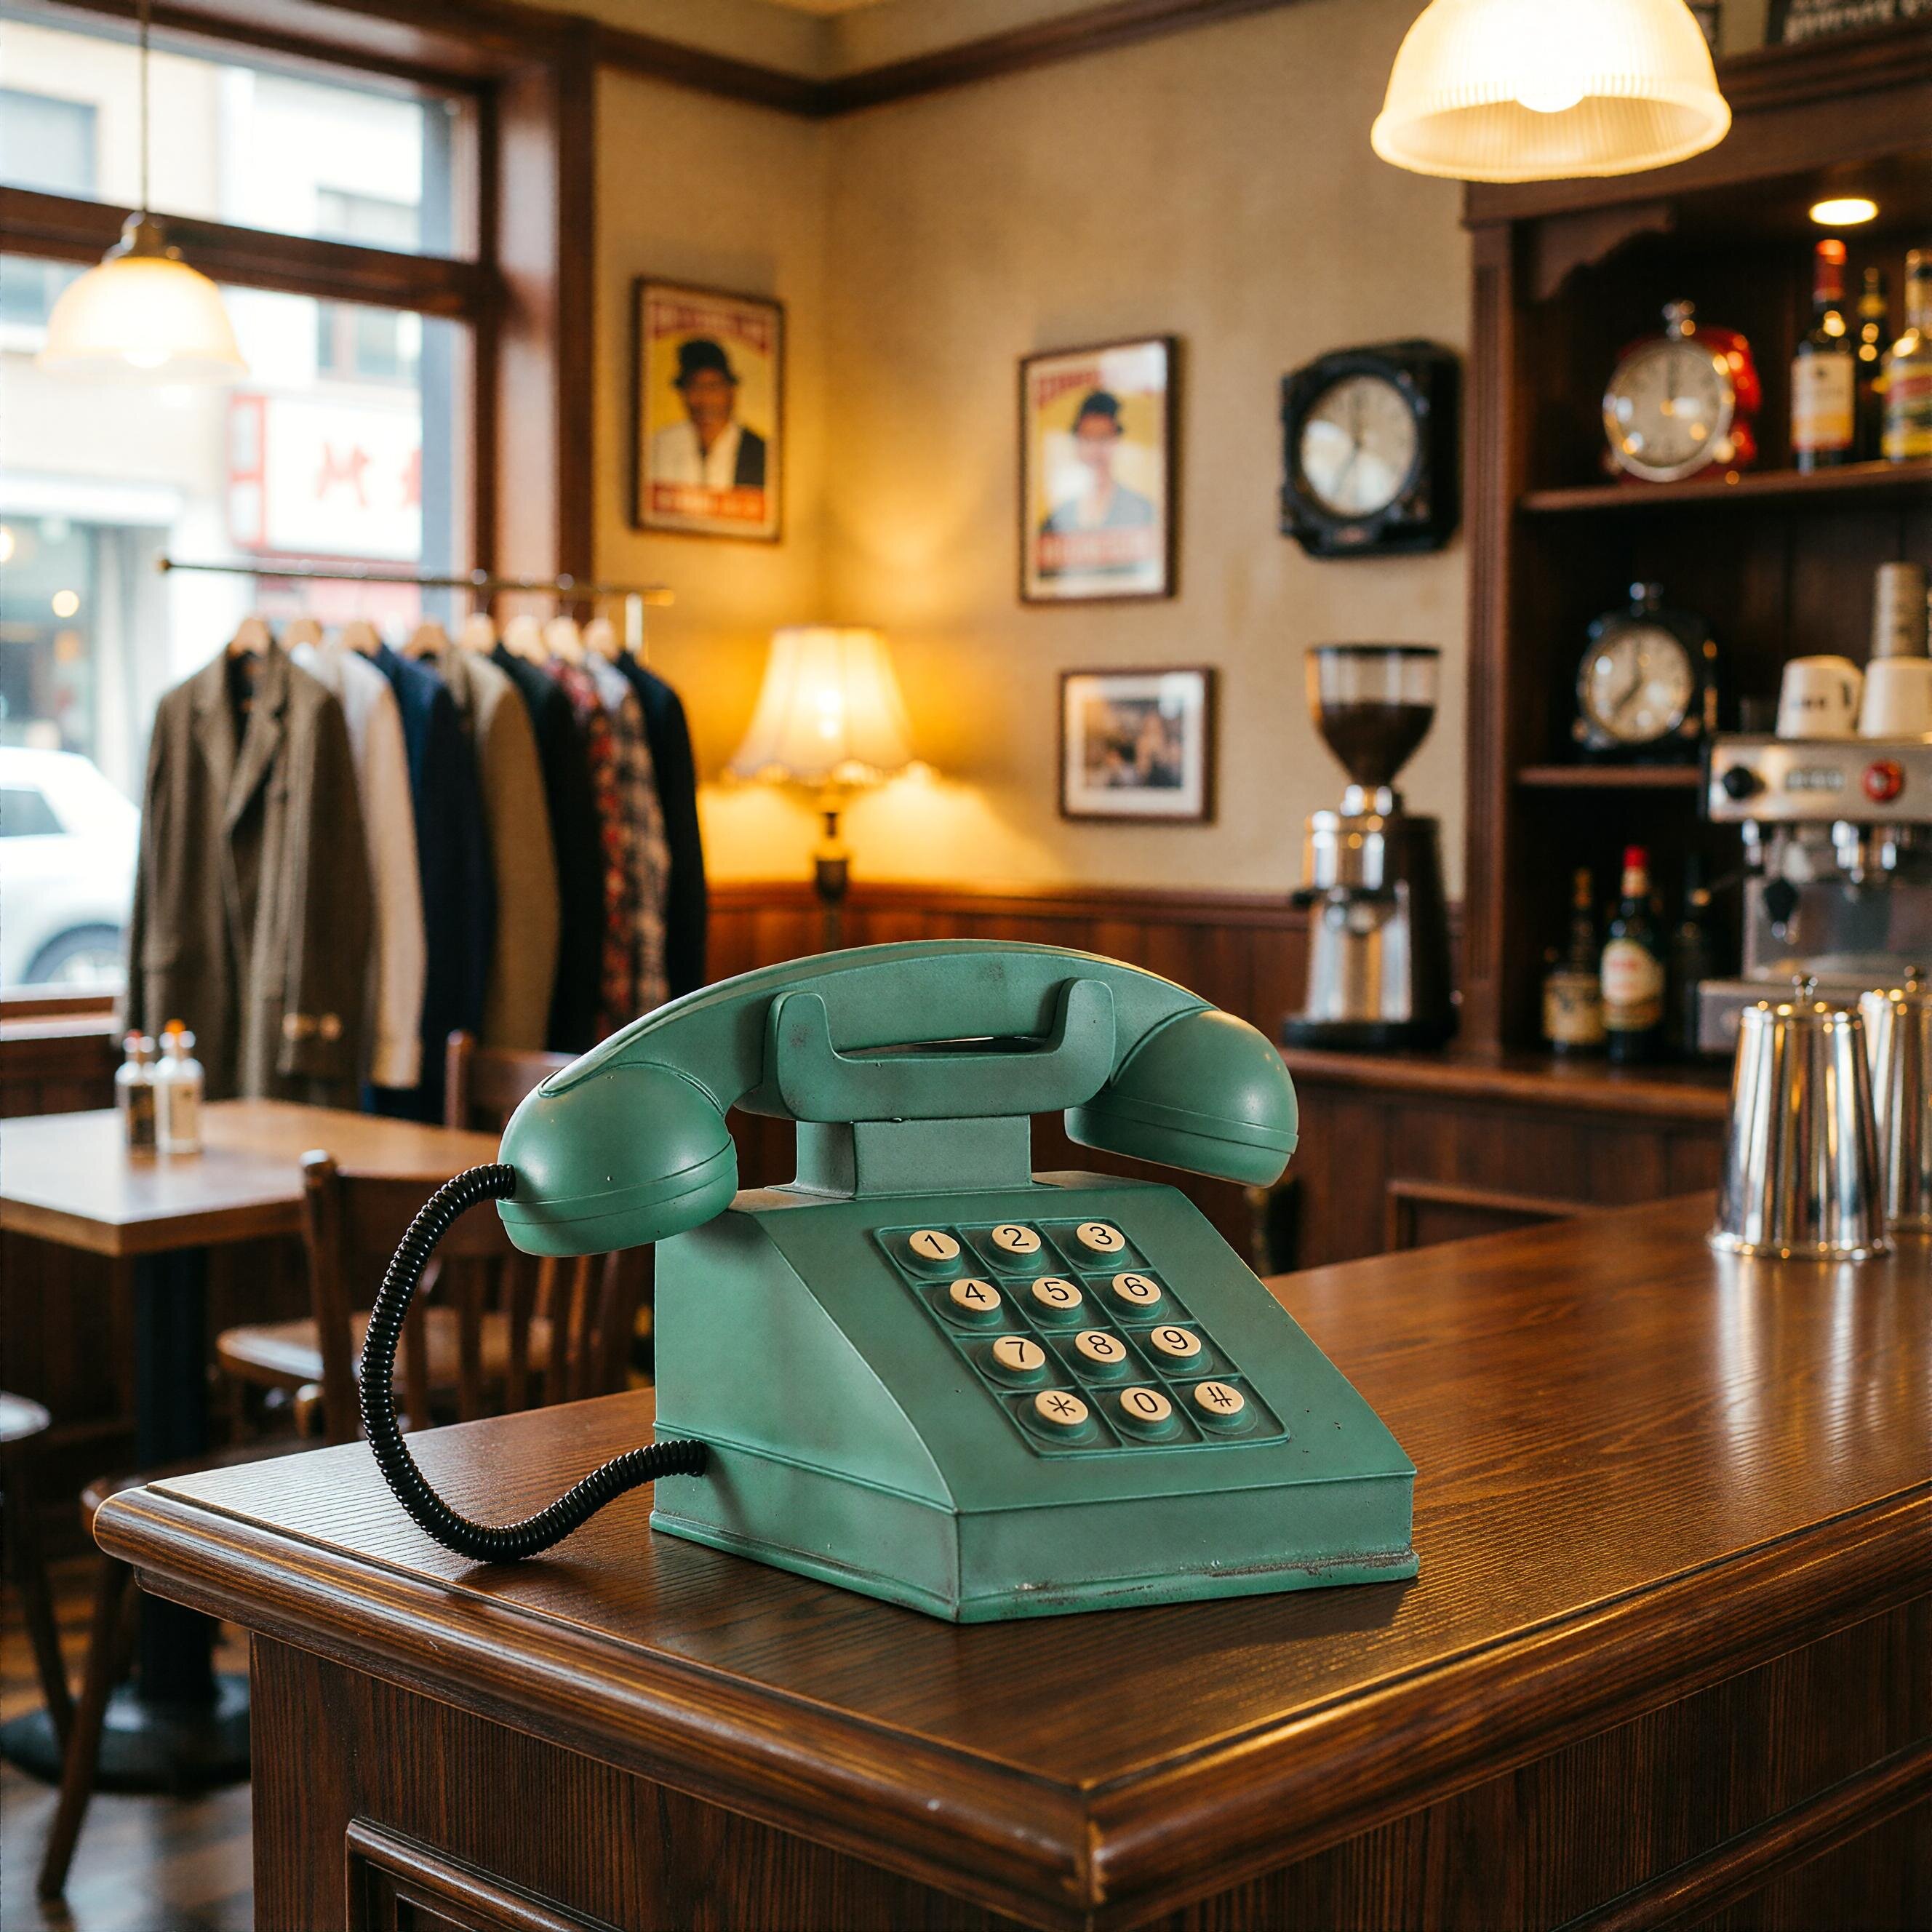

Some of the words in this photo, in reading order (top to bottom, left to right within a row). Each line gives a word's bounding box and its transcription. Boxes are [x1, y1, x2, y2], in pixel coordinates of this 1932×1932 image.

[924, 1234, 945, 1254] 1
[1002, 1227, 1030, 1247] 2
[1089, 1226, 1113, 1245] 3
[965, 1282, 986, 1304] 4
[1043, 1281, 1069, 1301] 5
[1123, 1277, 1149, 1297] 6
[1005, 1341, 1025, 1362] 7
[1087, 1335, 1114, 1355] 8
[1162, 1330, 1189, 1350] 9
[1133, 1392, 1159, 1413] 0
[1207, 1386, 1233, 1408] #
